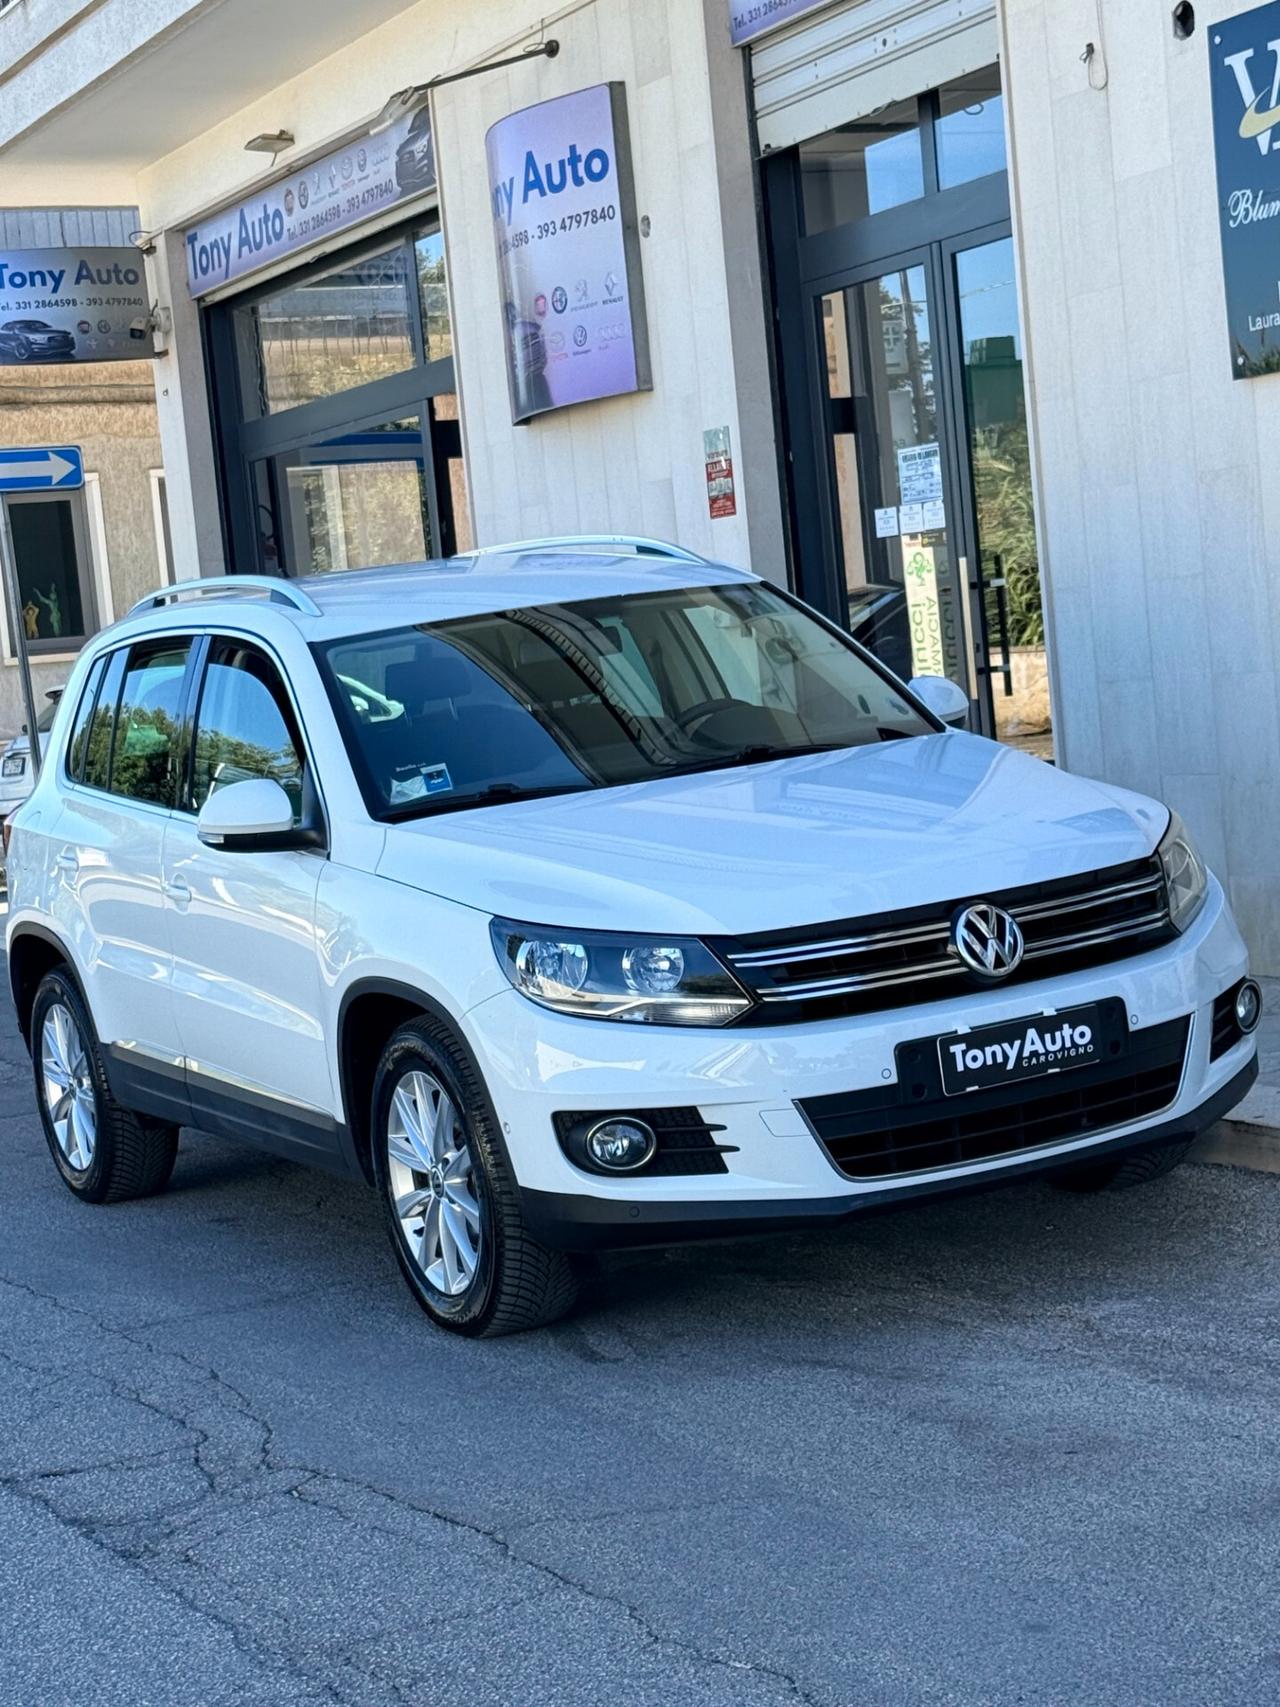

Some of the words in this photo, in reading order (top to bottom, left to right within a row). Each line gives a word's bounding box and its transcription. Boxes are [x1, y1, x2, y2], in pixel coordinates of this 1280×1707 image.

[733, 13, 747, 31] Tel.
[748, 6, 761, 23] 331
[522, 144, 610, 204] Auto
[299, 219, 311, 237] 331
[311, 204, 340, 231] 2864598
[346, 195, 360, 214] 393
[361, 178, 394, 205] 4797840
[537, 220, 558, 240] 393
[560, 204, 616, 233] 4797840
[187, 231, 233, 280] Tony
[238, 203, 284, 259] Auto
[0, 263, 66, 294] Tony
[74, 259, 140, 285] Auto
[15, 300, 32, 311] 331
[34, 298, 78, 310] 2864598
[85, 297, 103, 307] 393
[105, 297, 144, 307] 4797840
[1248, 313, 1280, 332] Laura
[1022, 1045, 1094, 1067] CAROVIGNO
